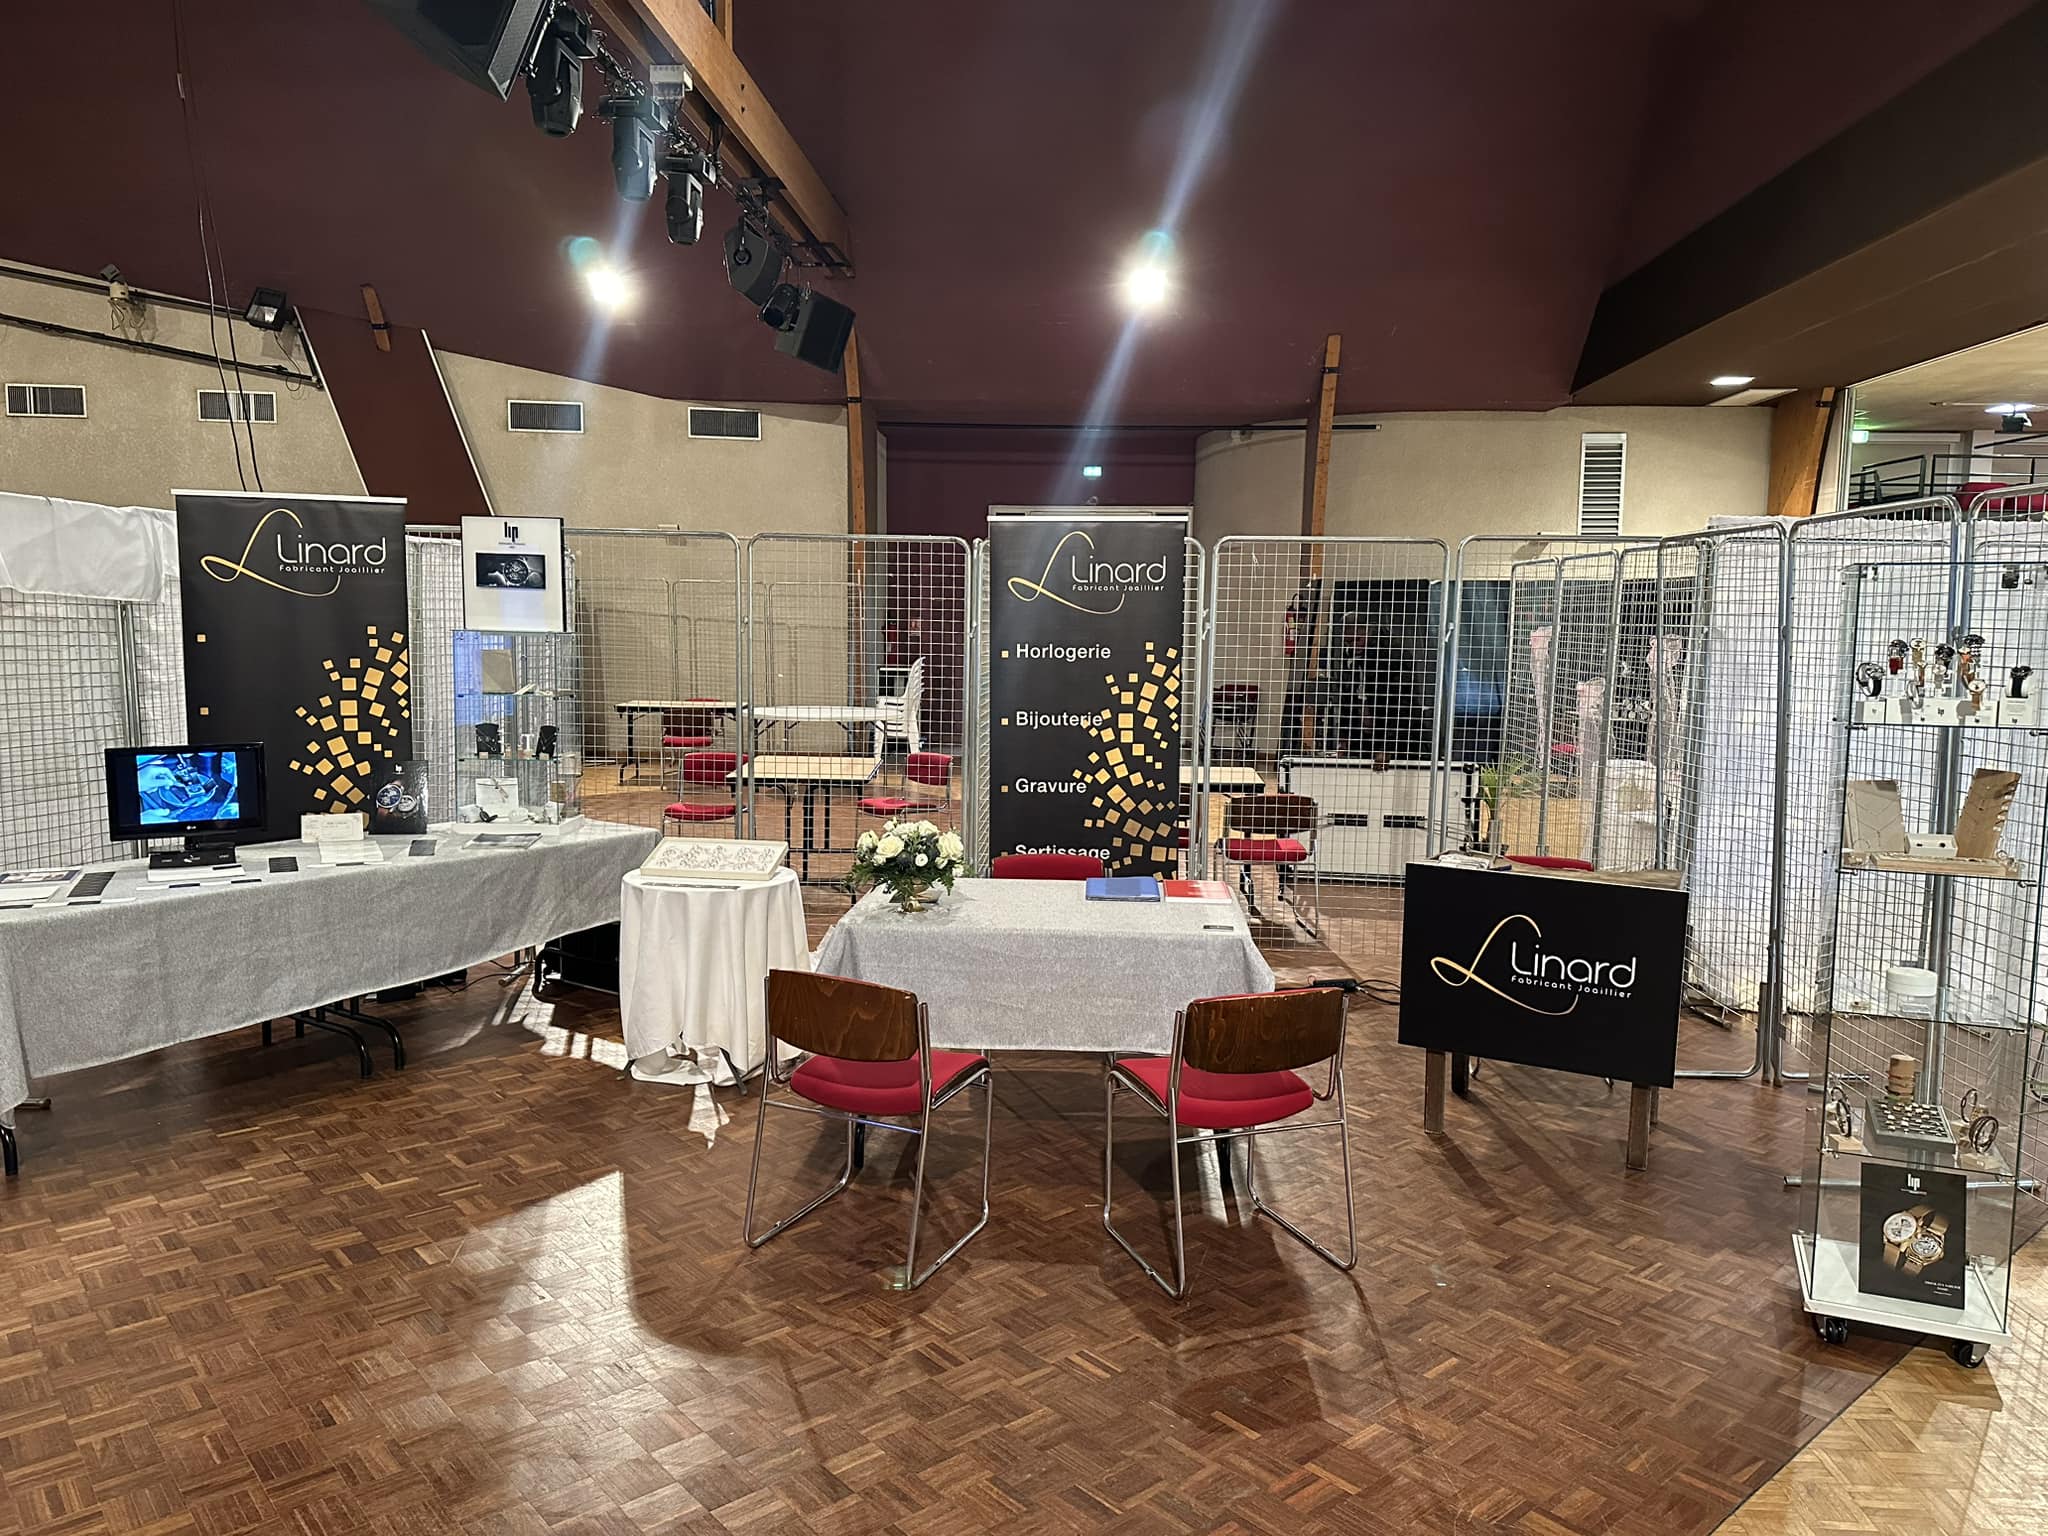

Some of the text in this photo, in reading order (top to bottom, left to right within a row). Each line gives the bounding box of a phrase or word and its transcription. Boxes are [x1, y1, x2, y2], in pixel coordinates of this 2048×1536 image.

[277, 533, 387, 566] Linard
[279, 564, 385, 574] Fabricant Joaillier
[1071, 554, 1167, 583] Linard
[1072, 584, 1165, 592] Fabricant Joaillier
[1016, 643, 1111, 663] Horlogerie
[1016, 711, 1103, 730] Bijouterie
[1015, 778, 1087, 794] Gravure
[1511, 941, 1637, 989] Linard
[1511, 975, 1632, 999] Fabricant Joaillier
